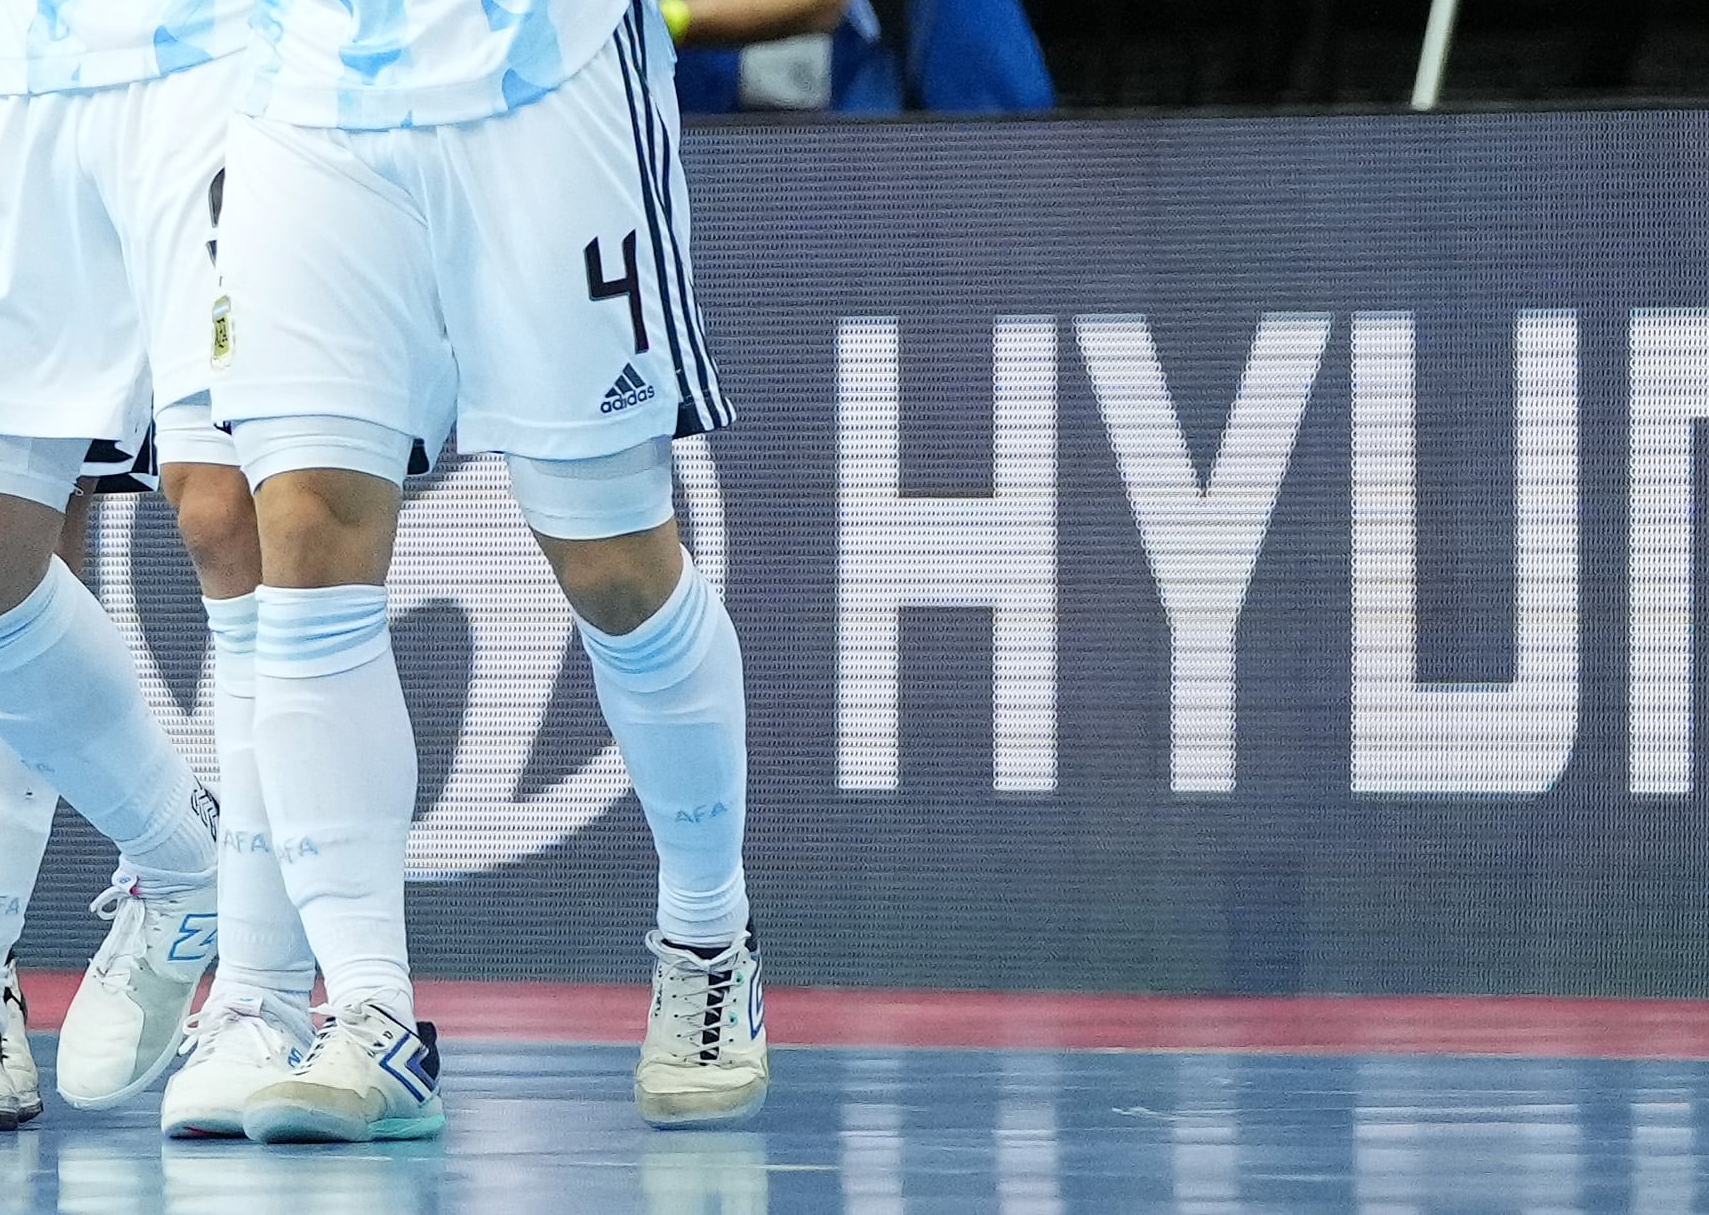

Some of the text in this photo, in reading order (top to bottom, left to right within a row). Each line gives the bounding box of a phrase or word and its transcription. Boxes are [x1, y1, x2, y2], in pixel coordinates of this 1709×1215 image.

[583, 227, 649, 355] 4
[600, 386, 655, 414] adidas
[224, 829, 270, 854] AFA
